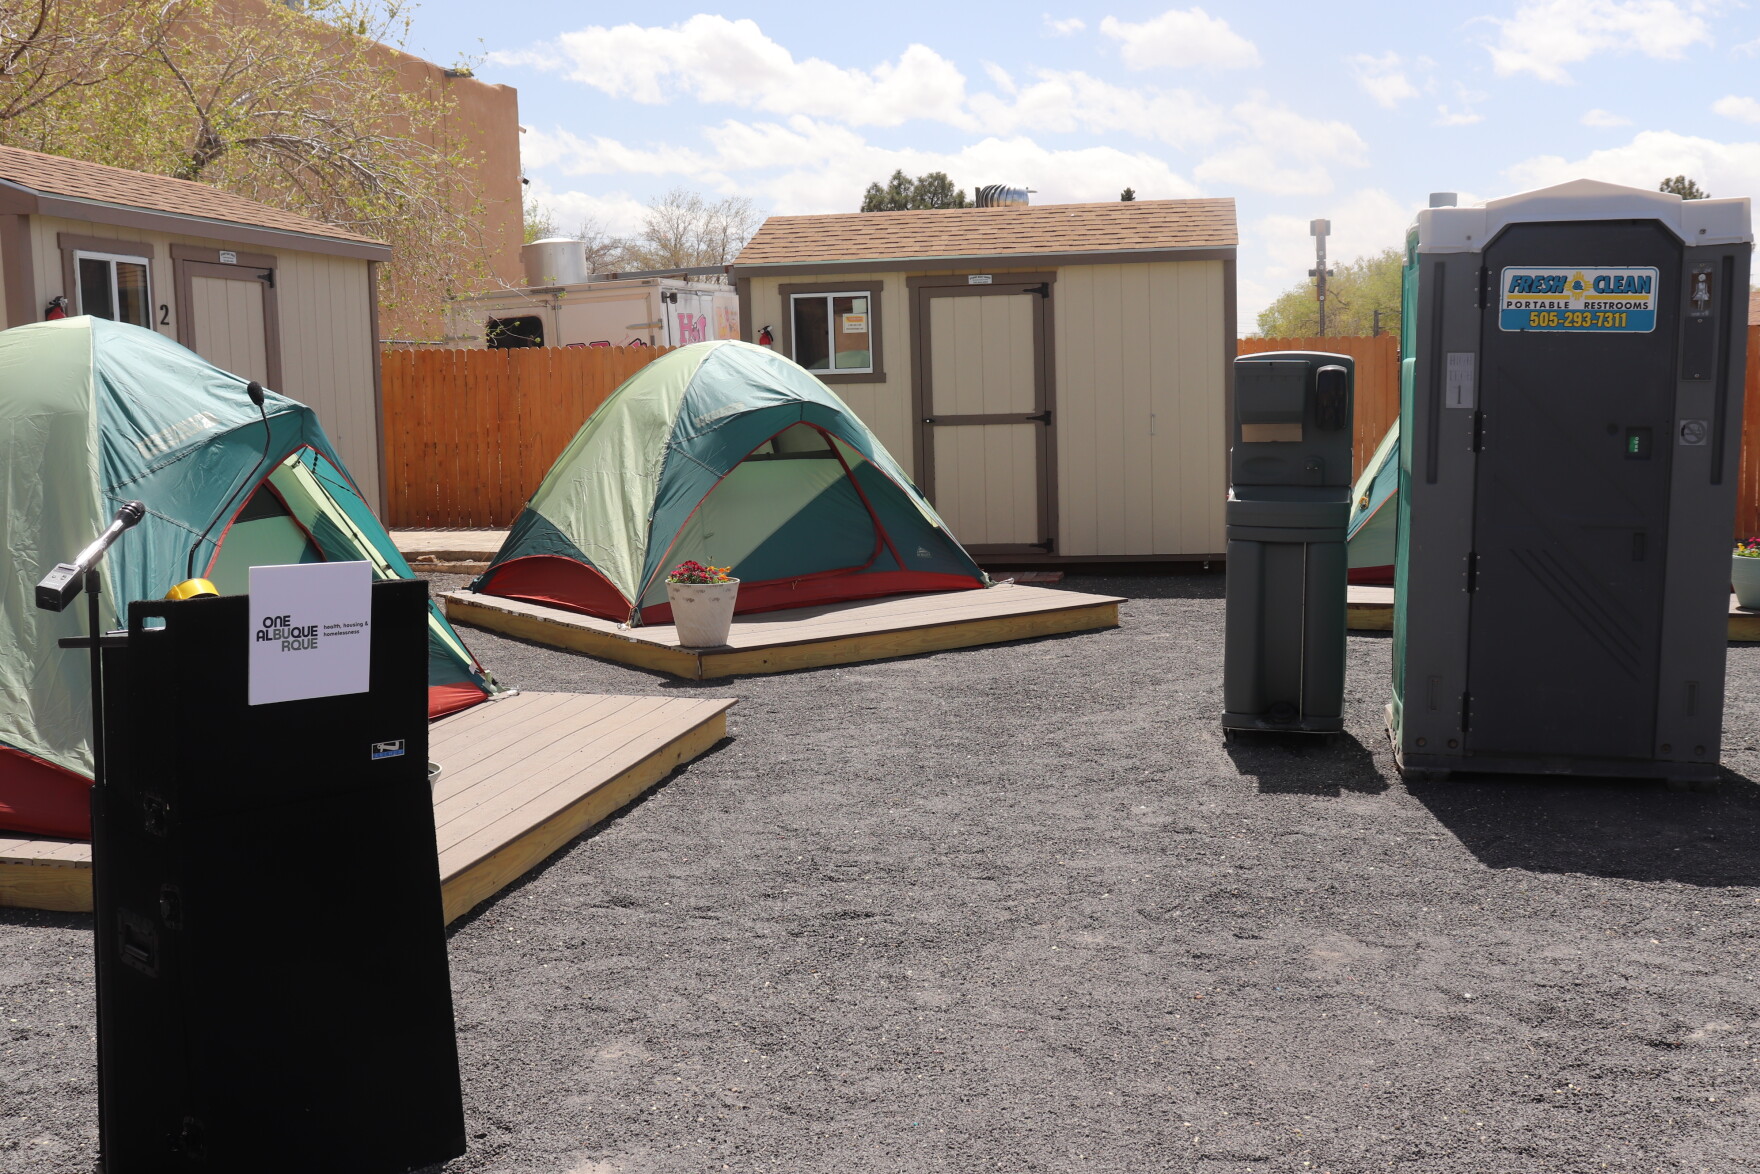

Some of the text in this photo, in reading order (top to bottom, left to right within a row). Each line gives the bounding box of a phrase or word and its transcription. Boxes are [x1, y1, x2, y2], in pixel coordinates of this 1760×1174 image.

[1508, 275, 1652, 294] FRESH & CLEAN
[1506, 301, 1649, 310] PORTABLE RESTROOMS
[160, 304, 170, 325] 2
[1530, 311, 1627, 327] 505-293-7311
[1457, 384, 1462, 404] 1
[262, 614, 291, 629] ONE
[343, 621, 364, 629] housing
[256, 625, 319, 642] ALBUQUE
[323, 629, 360, 637] homelessness
[281, 637, 318, 652] RQUE
